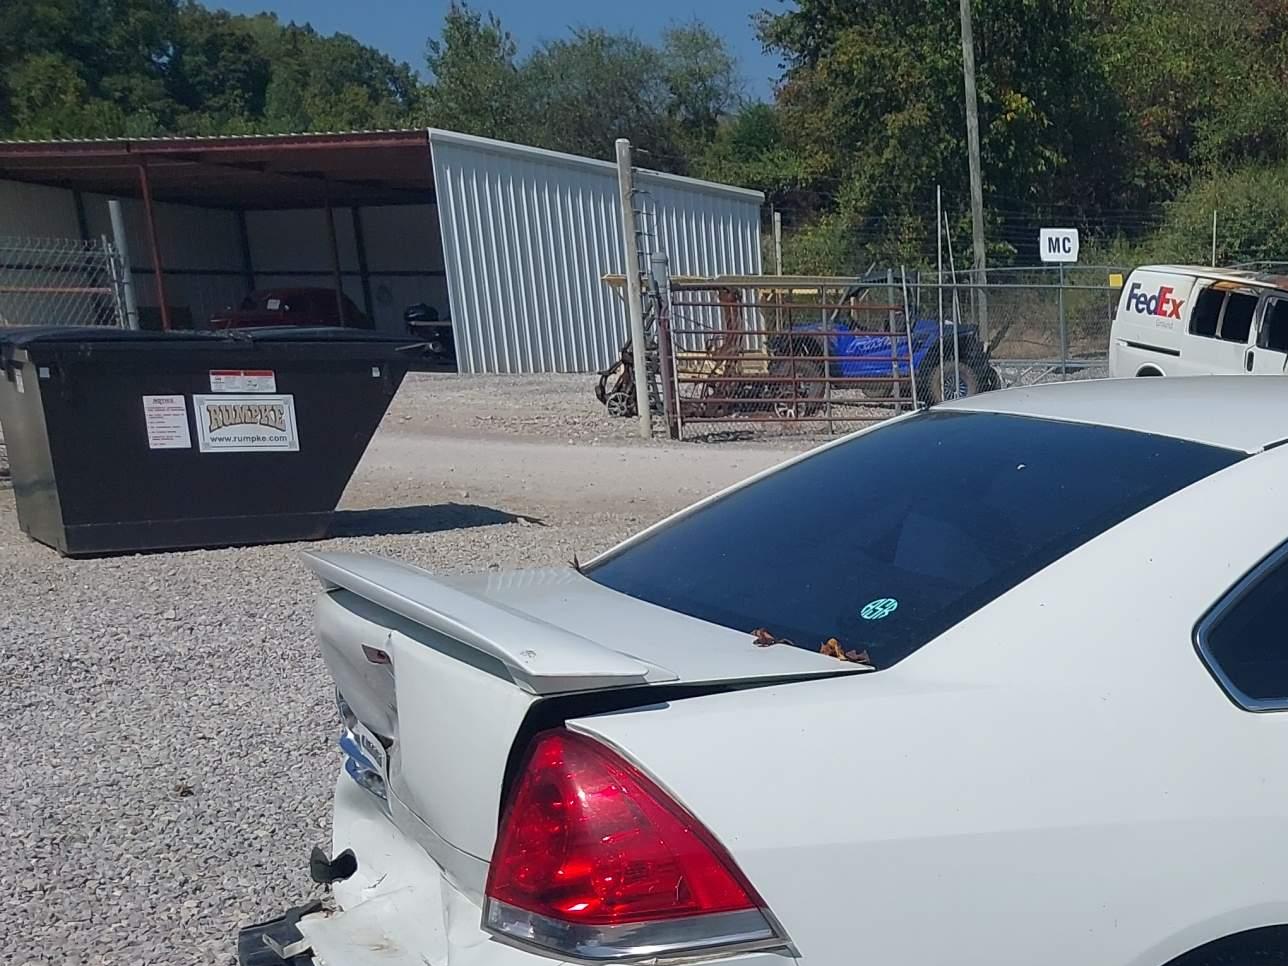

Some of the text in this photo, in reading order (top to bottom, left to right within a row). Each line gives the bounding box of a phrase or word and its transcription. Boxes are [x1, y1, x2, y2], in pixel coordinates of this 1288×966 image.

[1047, 236, 1072, 254] MC
[1126, 282, 1185, 320] FedEx
[206, 404, 287, 433] RUMPKE
[210, 434, 288, 444] www.rumpke.com
